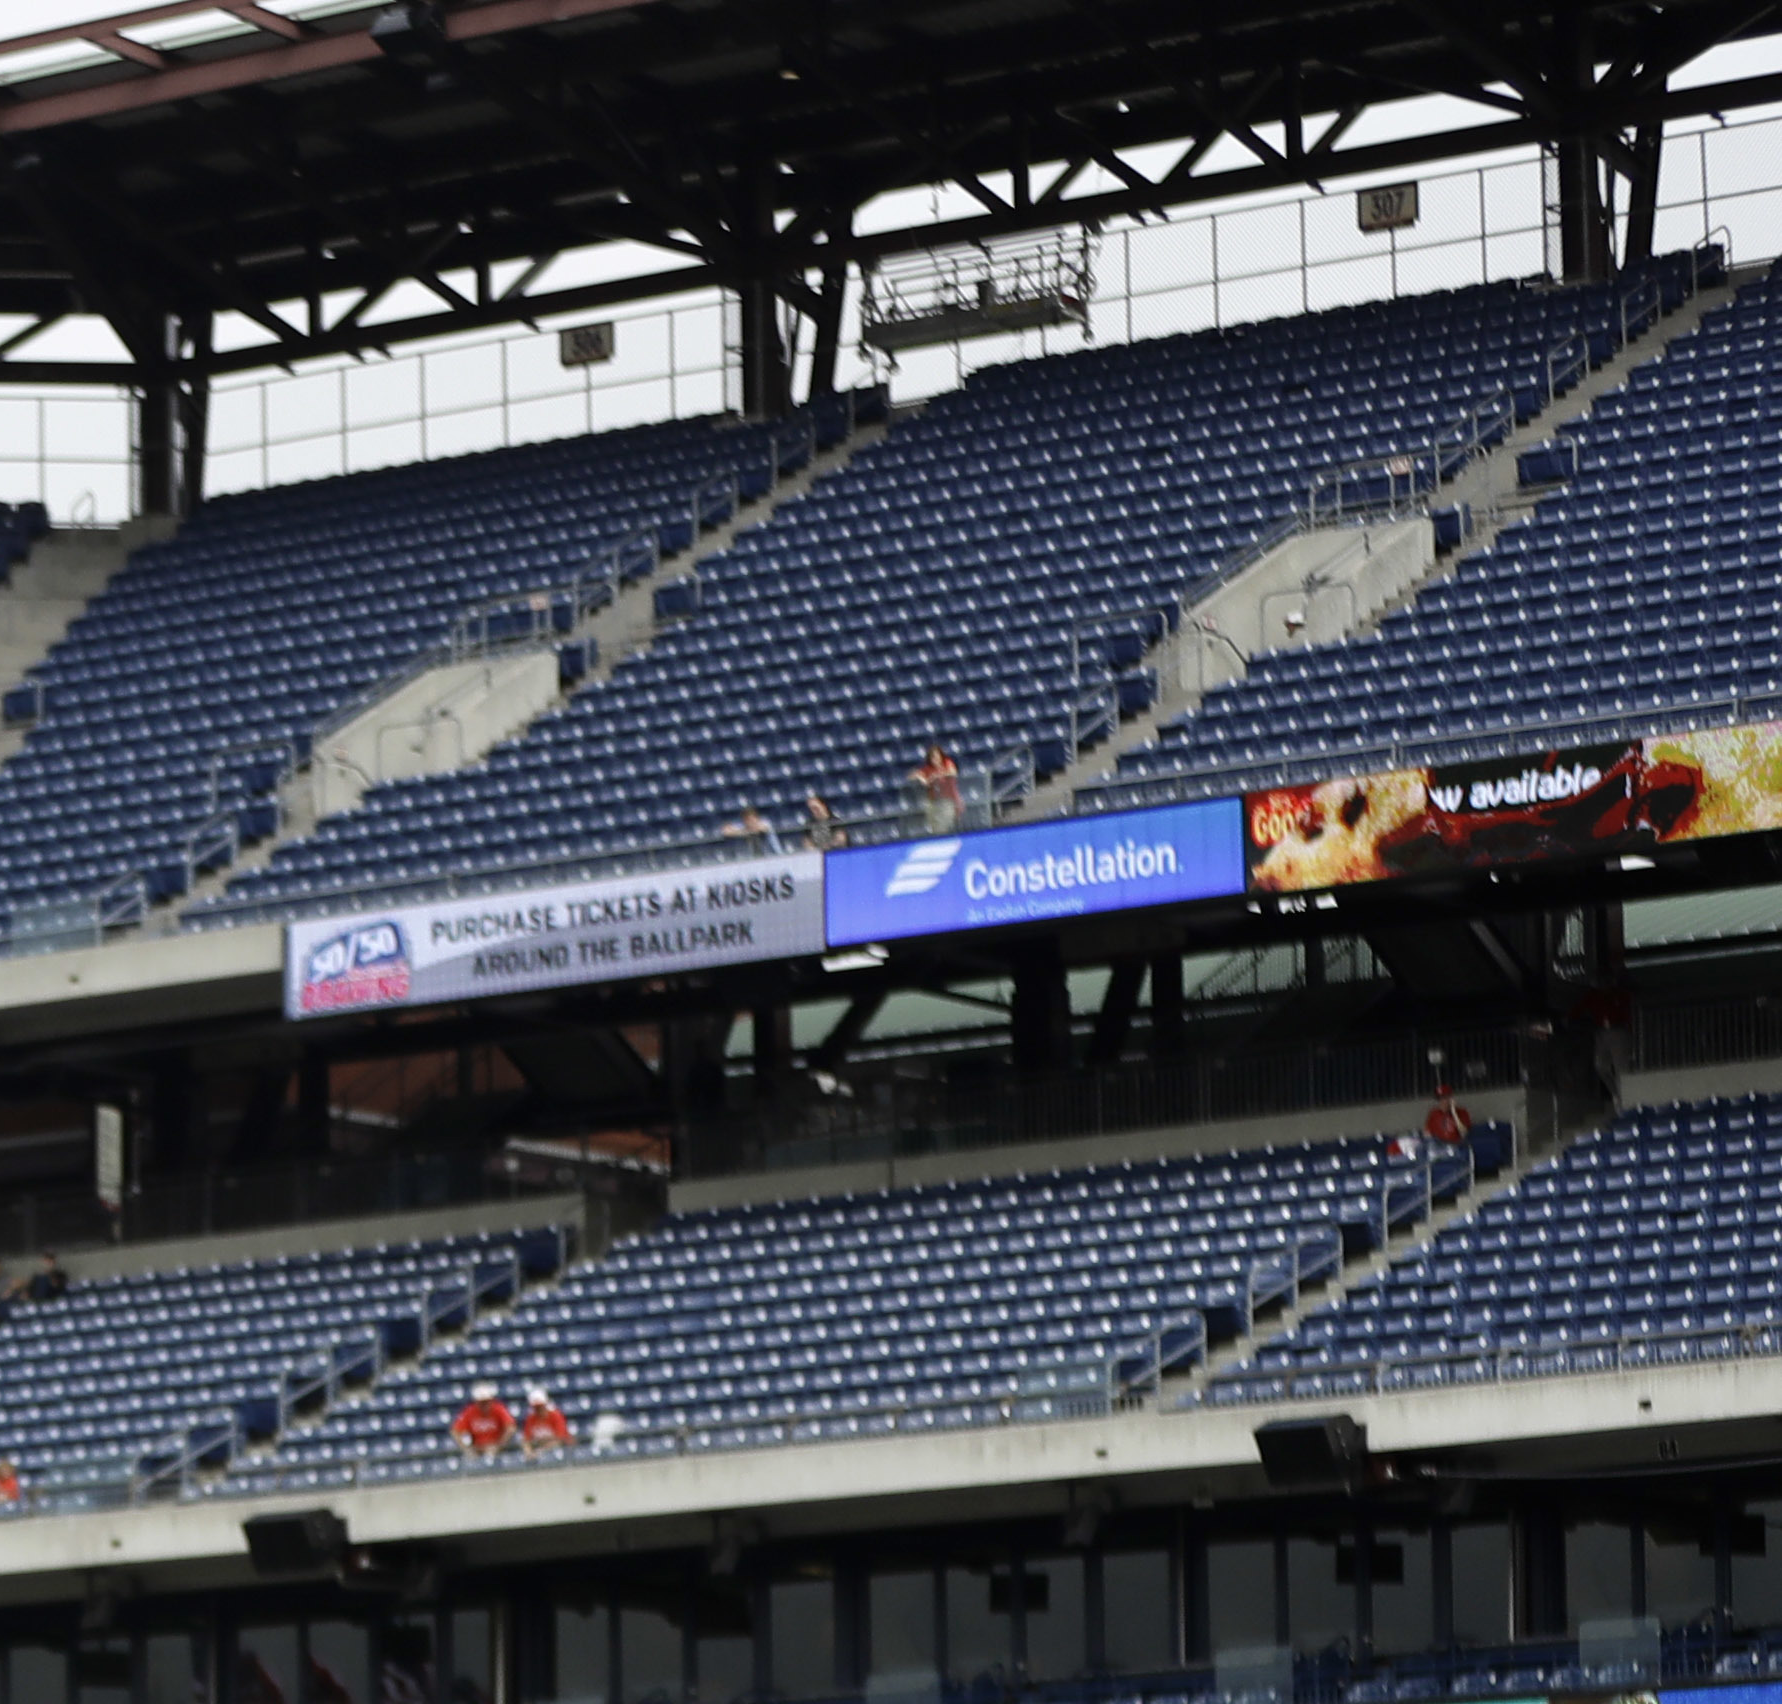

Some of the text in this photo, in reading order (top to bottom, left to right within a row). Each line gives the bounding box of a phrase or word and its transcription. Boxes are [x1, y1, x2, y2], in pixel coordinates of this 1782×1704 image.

[1470, 762, 1601, 809] available
[431, 873, 795, 944] PURCHASE TICKETS AT KIOSKS
[473, 919, 754, 978] AROUND THE BALLPARK
